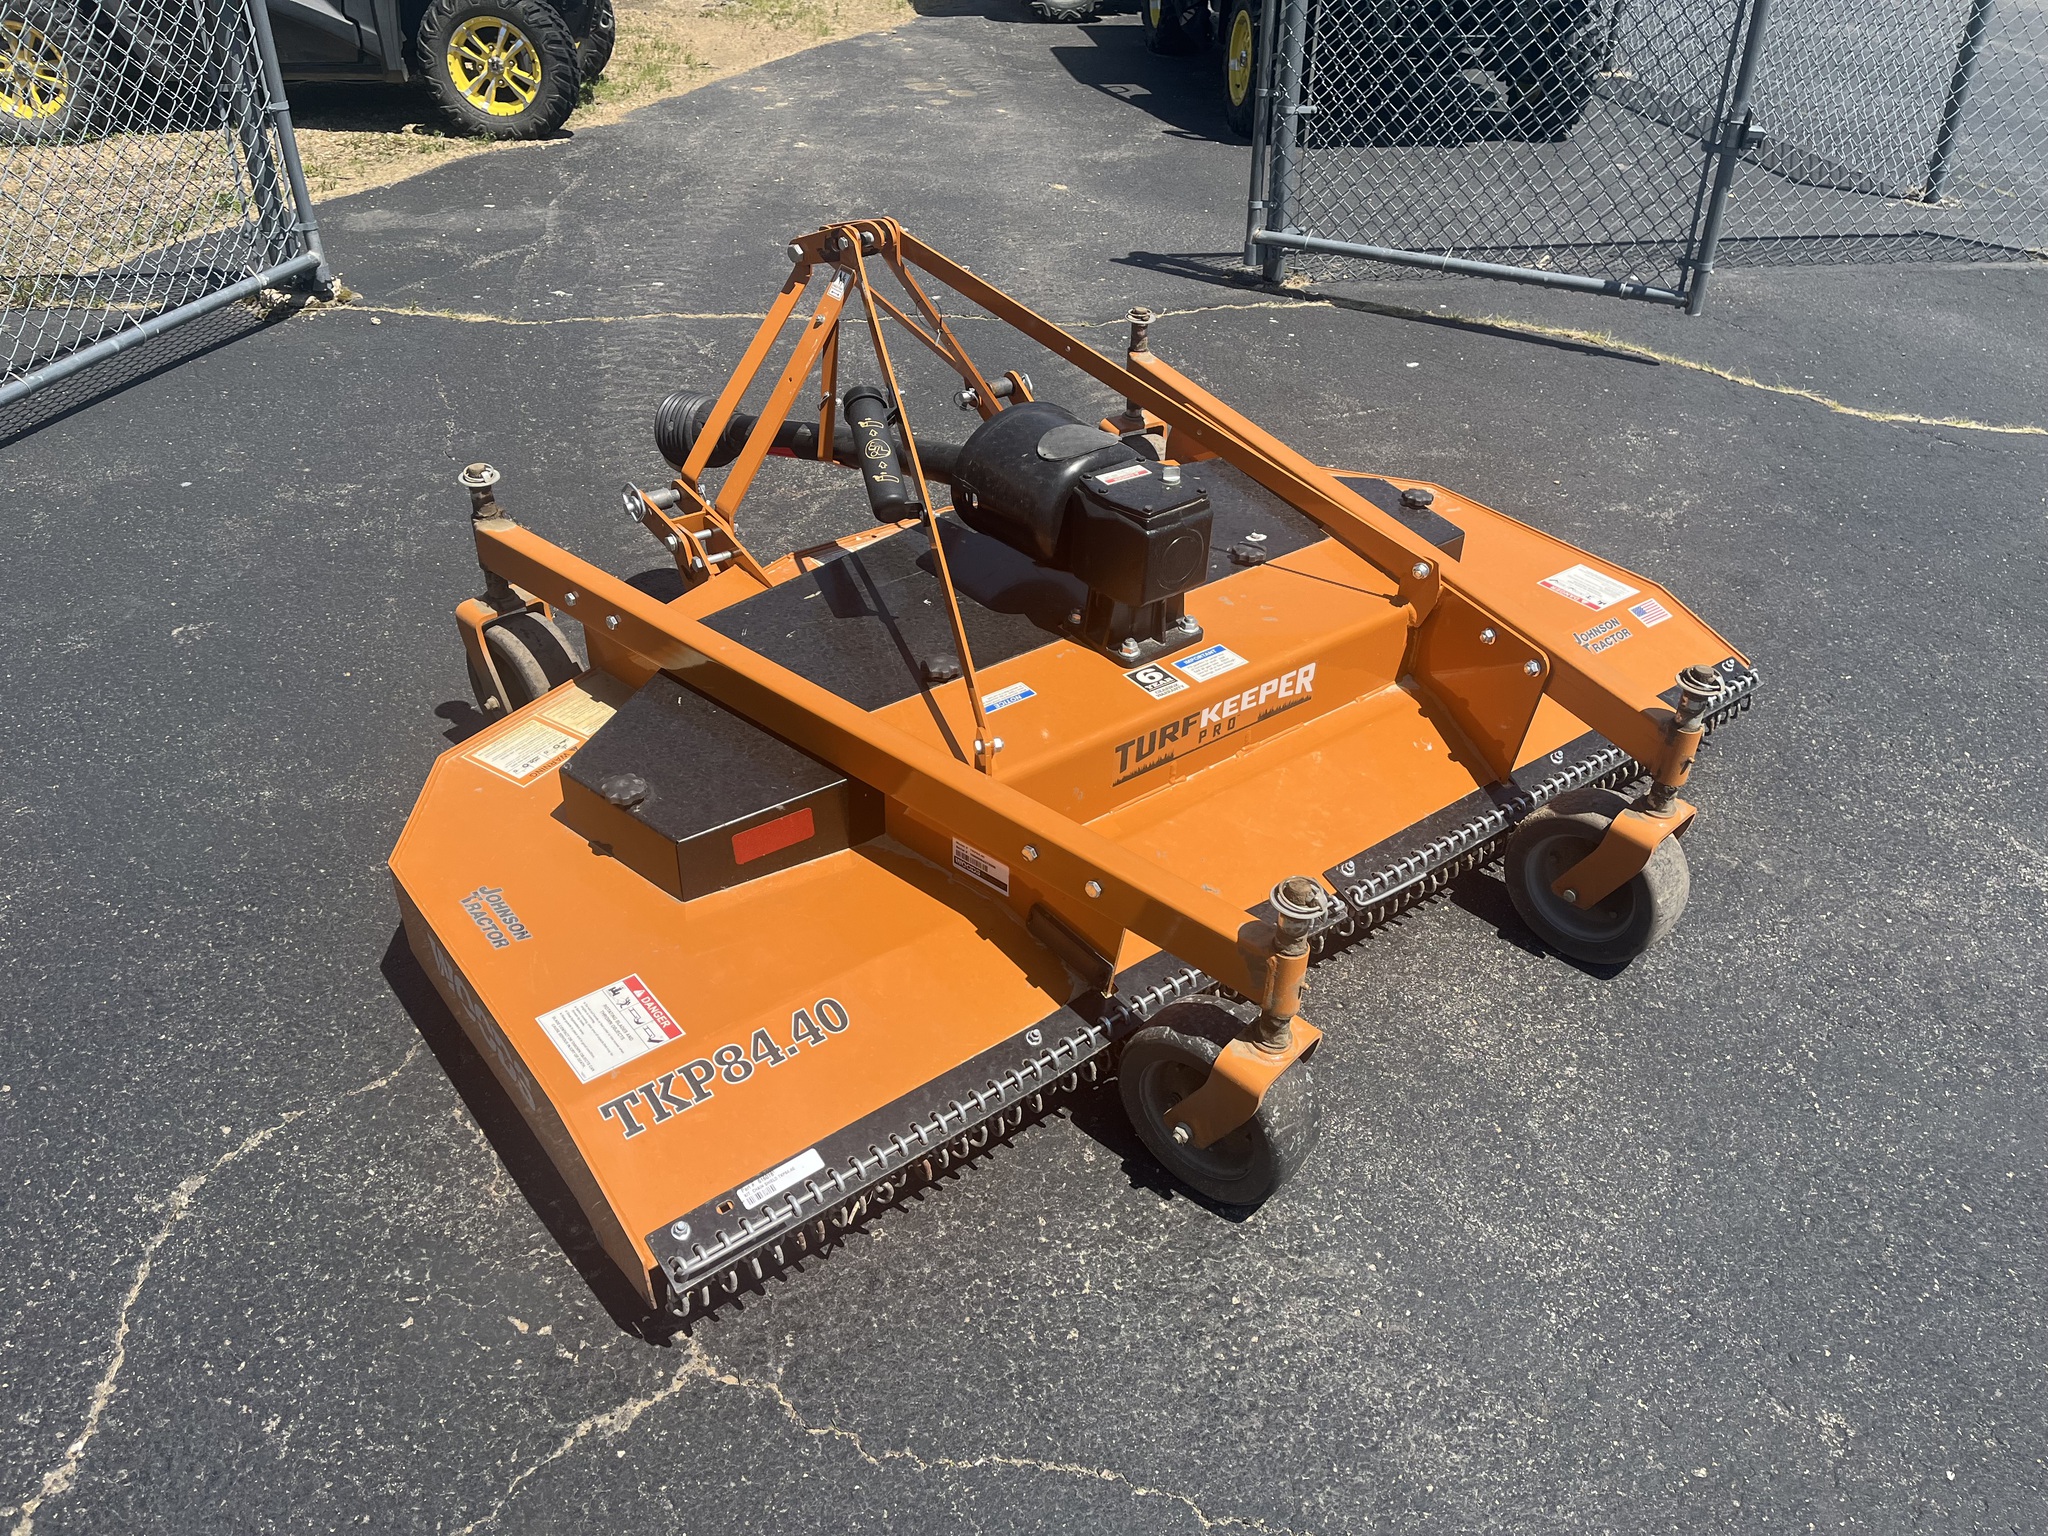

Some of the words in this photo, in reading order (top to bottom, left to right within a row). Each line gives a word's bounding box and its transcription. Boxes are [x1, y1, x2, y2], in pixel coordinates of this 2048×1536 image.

[1573, 618, 1620, 645] JOHNSON
[1581, 628, 1632, 655] TRACTOR
[1184, 649, 1216, 665] IMPORTANT
[1136, 668, 1163, 684] 6
[1145, 677, 1176, 691] YEAR
[994, 694, 1022, 709] NOTICE
[1198, 716, 1237, 743] PRO
[529, 753, 570, 778] WARNING
[459, 891, 510, 950] TRACTOR
[478, 886, 532, 941] JOHNSON
[641, 997, 671, 1028] DANGER
[597, 998, 849, 1140] TKP84.40
